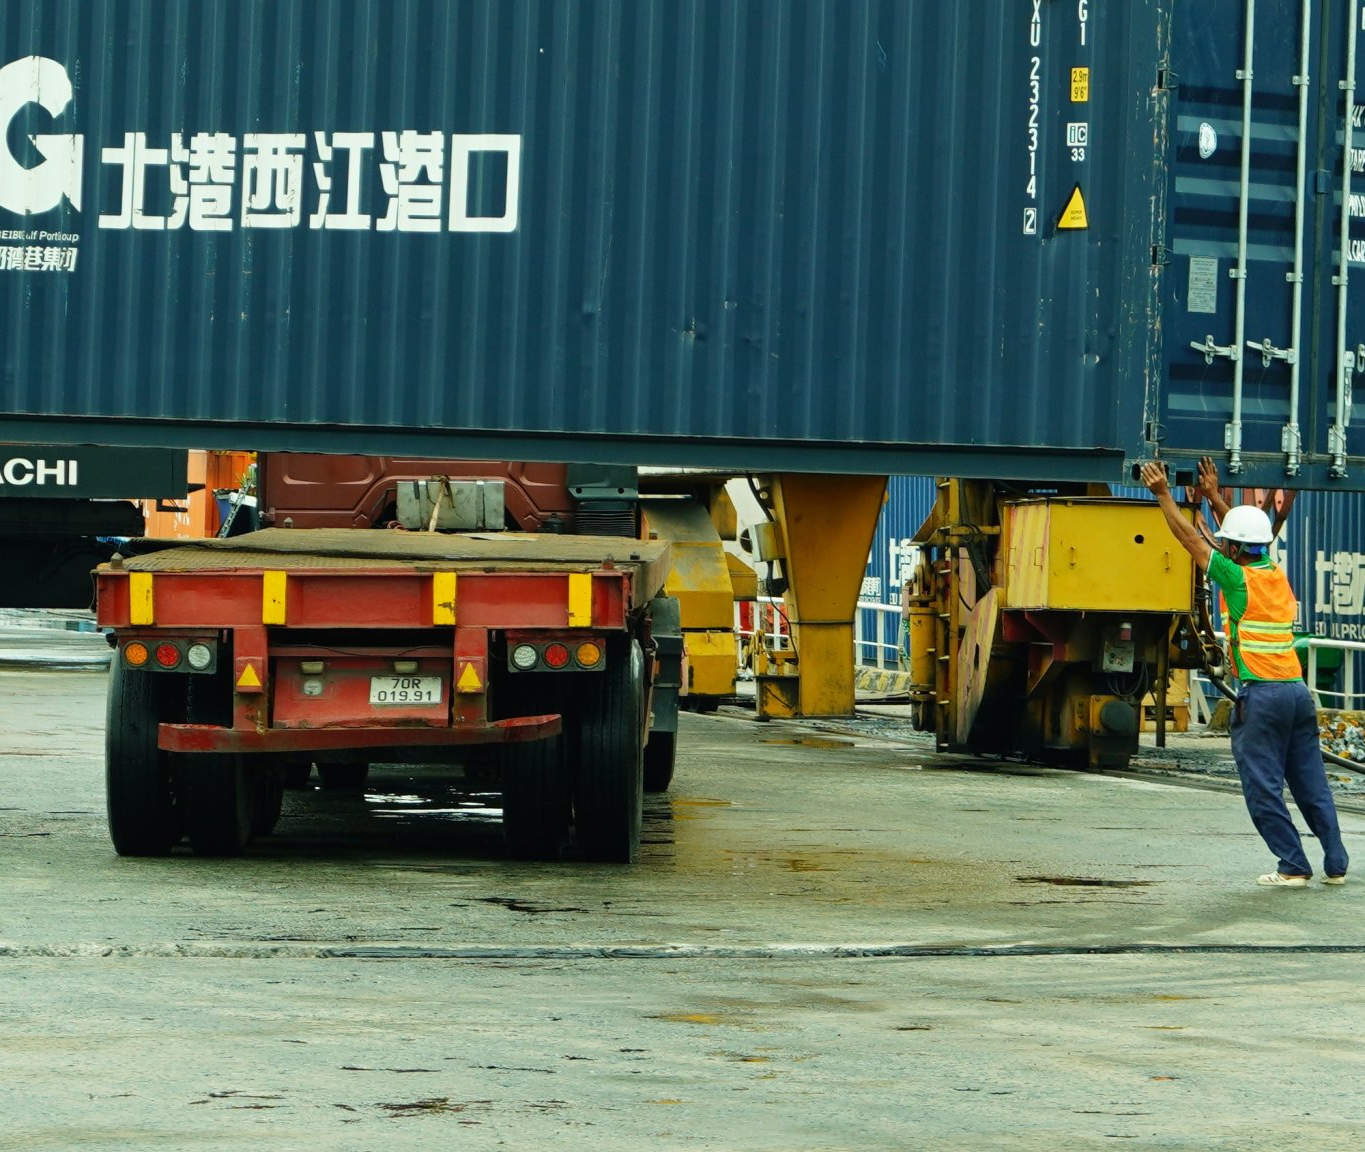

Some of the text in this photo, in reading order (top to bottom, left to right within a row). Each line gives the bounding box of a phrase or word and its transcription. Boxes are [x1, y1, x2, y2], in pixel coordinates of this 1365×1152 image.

[1351, 104, 1365, 127] AX
[1026, 56, 1040, 199] 232314
[1071, 148, 1085, 162] 33
[1024, 208, 1037, 235] 2
[391, 678, 421, 689] 70R
[378, 690, 432, 702] 019.91
